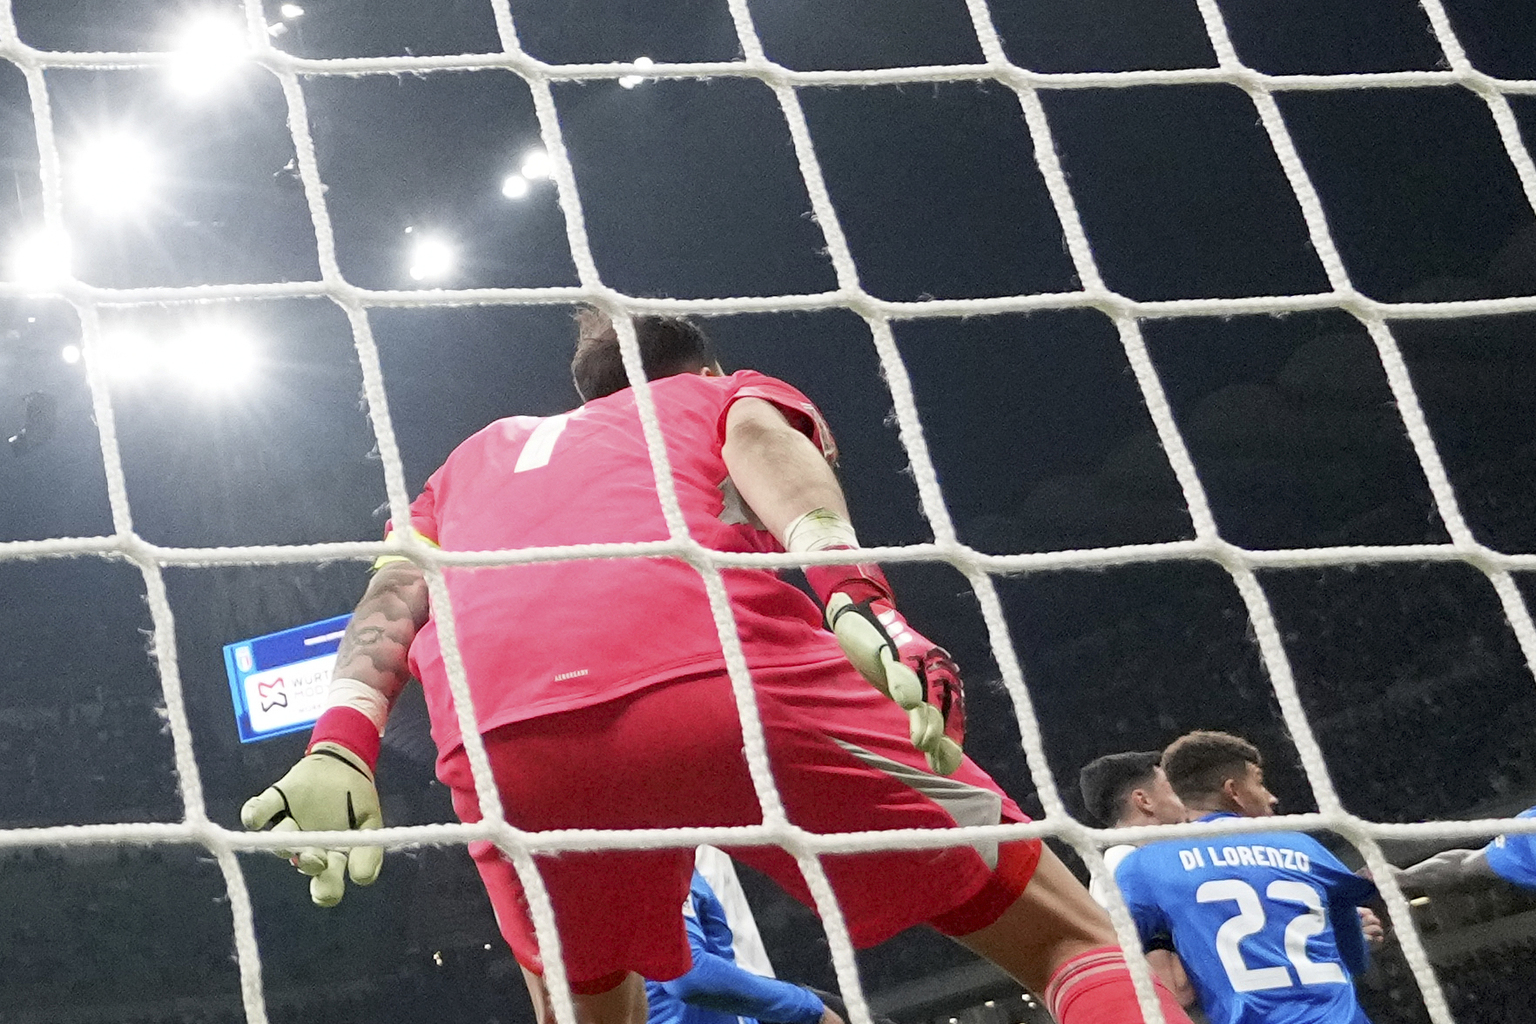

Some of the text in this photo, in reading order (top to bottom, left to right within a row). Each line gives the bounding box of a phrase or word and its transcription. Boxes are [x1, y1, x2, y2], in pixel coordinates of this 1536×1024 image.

[1179, 845, 1311, 873] DI LORENZO
[1196, 878, 1348, 993] 22
